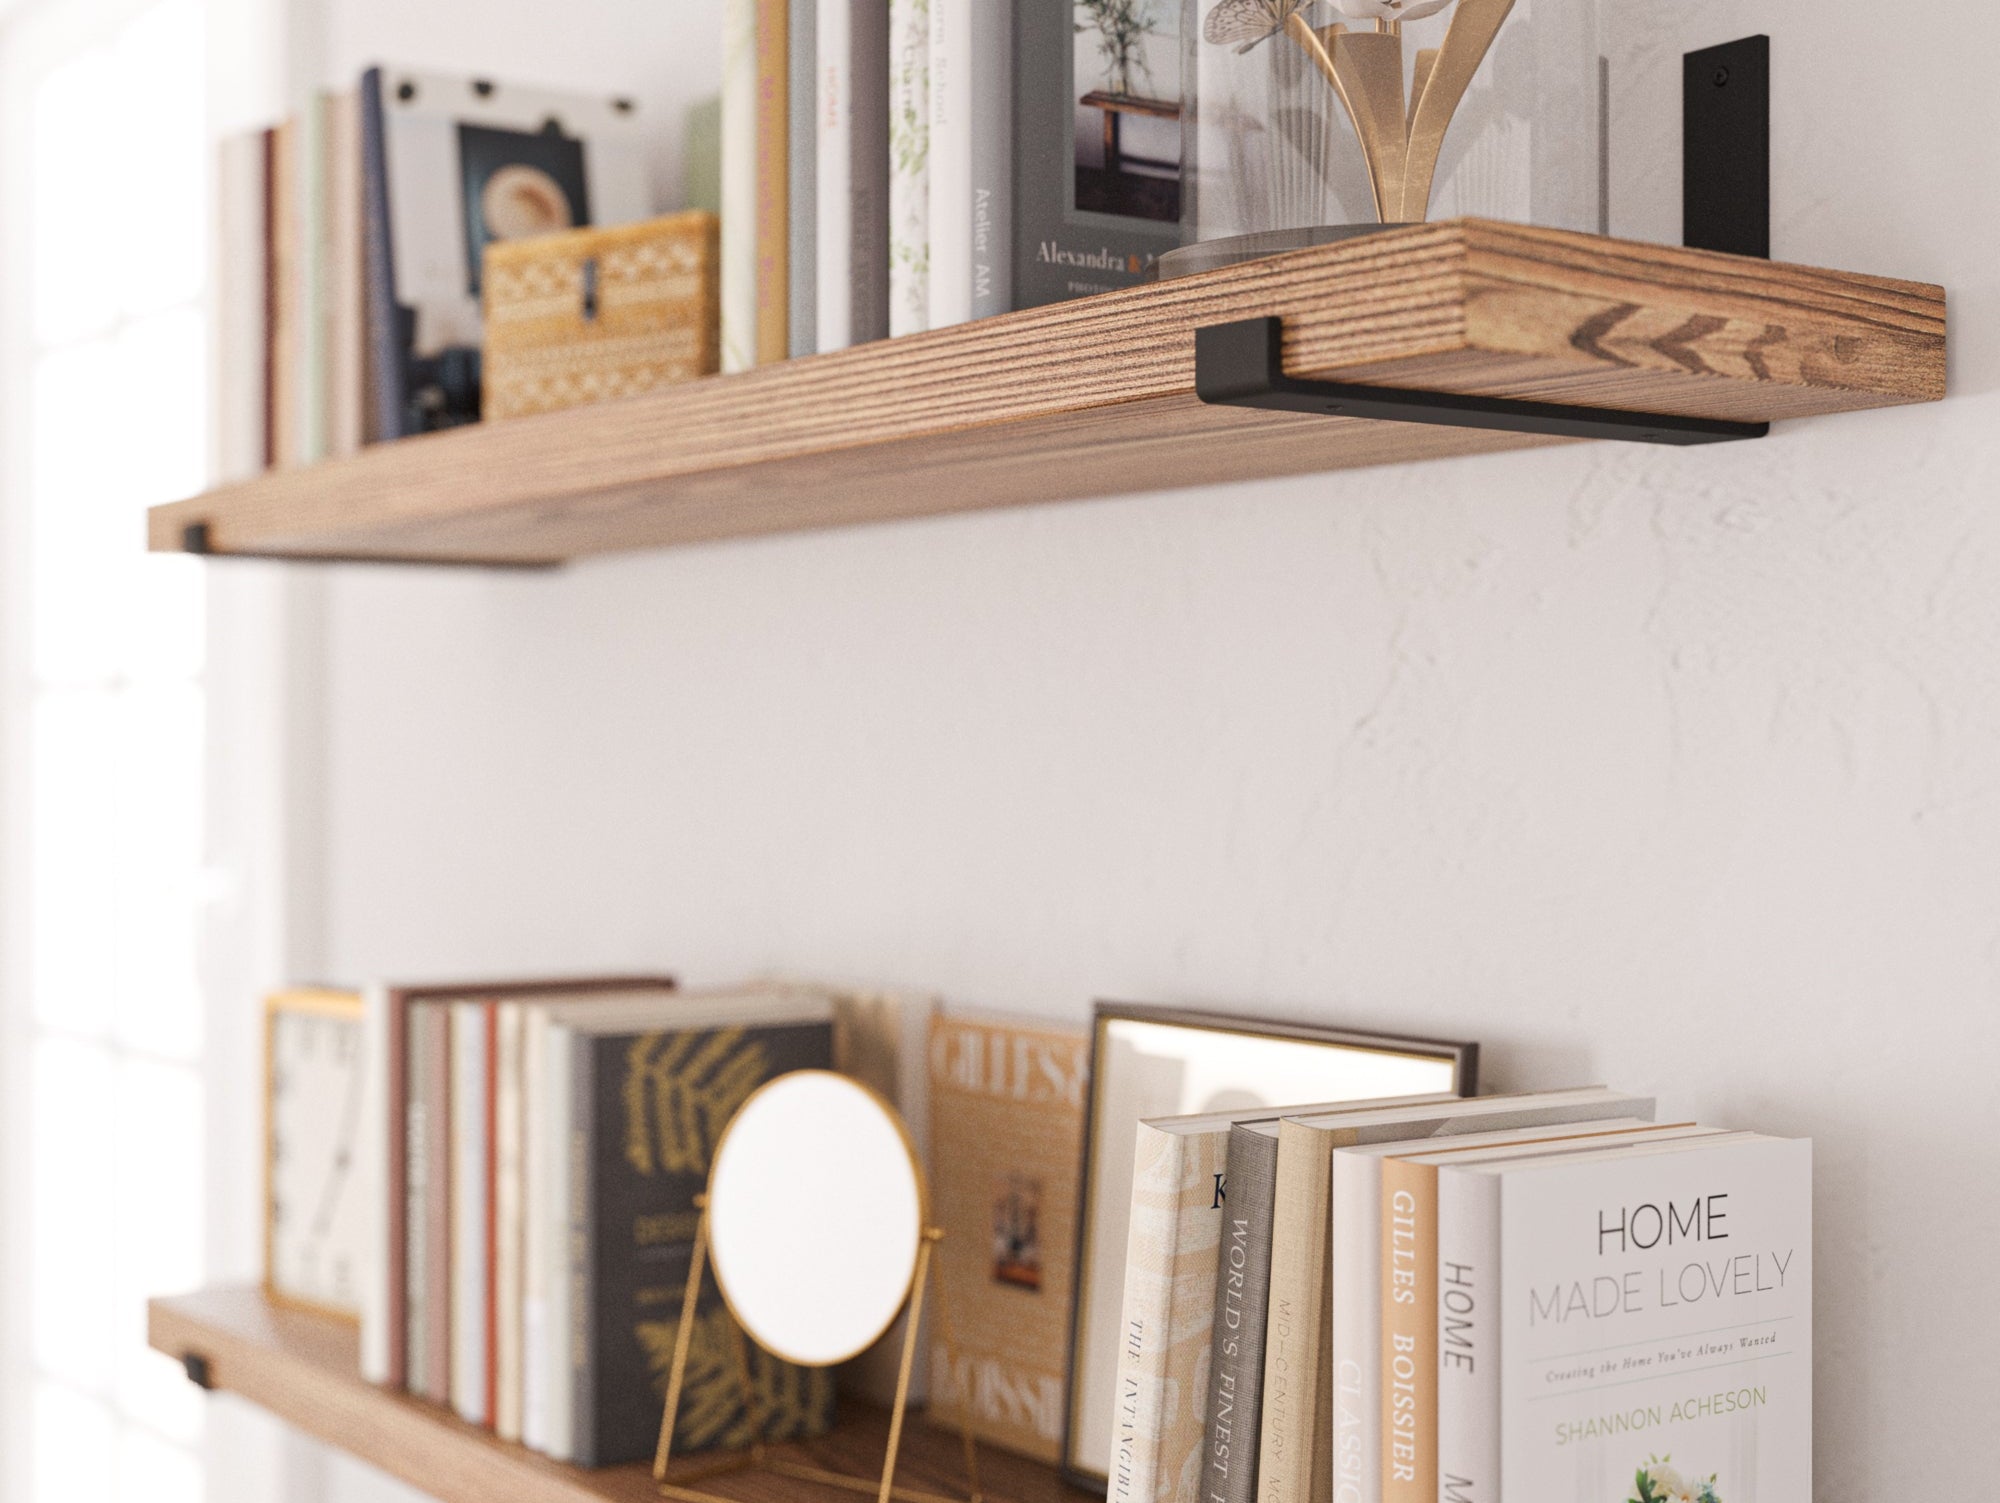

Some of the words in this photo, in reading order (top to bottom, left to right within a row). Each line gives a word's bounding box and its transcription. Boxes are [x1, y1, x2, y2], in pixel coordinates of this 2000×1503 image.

[975, 188, 990, 253] Atelier
[1036, 240, 1125, 272] Alexandra
[975, 264, 990, 298] AM
[1392, 1190, 1416, 1305] GILLES
[1598, 1193, 1729, 1256] HOME
[1222, 1218, 1249, 1358] WORLD'S
[1444, 1260, 1475, 1374] HOME
[1529, 1271, 1643, 1327] MADE
[1660, 1249, 1793, 1307] LOVELY
[1127, 1319, 1144, 1364] THE
[1545, 1364, 1596, 1384] Creating
[1600, 1359, 1618, 1374] the
[1622, 1356, 1653, 1370] Home
[1657, 1348, 1692, 1364] You've
[1697, 1341, 1734, 1358] Always
[1739, 1332, 1777, 1349] Wanted
[1270, 1299, 1292, 1463] MID-CENTURY
[1391, 1332, 1416, 1482] BOISSIER
[1554, 1405, 1662, 1447] SHANNON
[1669, 1386, 1768, 1424] ACHESON
[1114, 1378, 1139, 1503] INTANGIBL
[1213, 1372, 1236, 1479] FINEST
